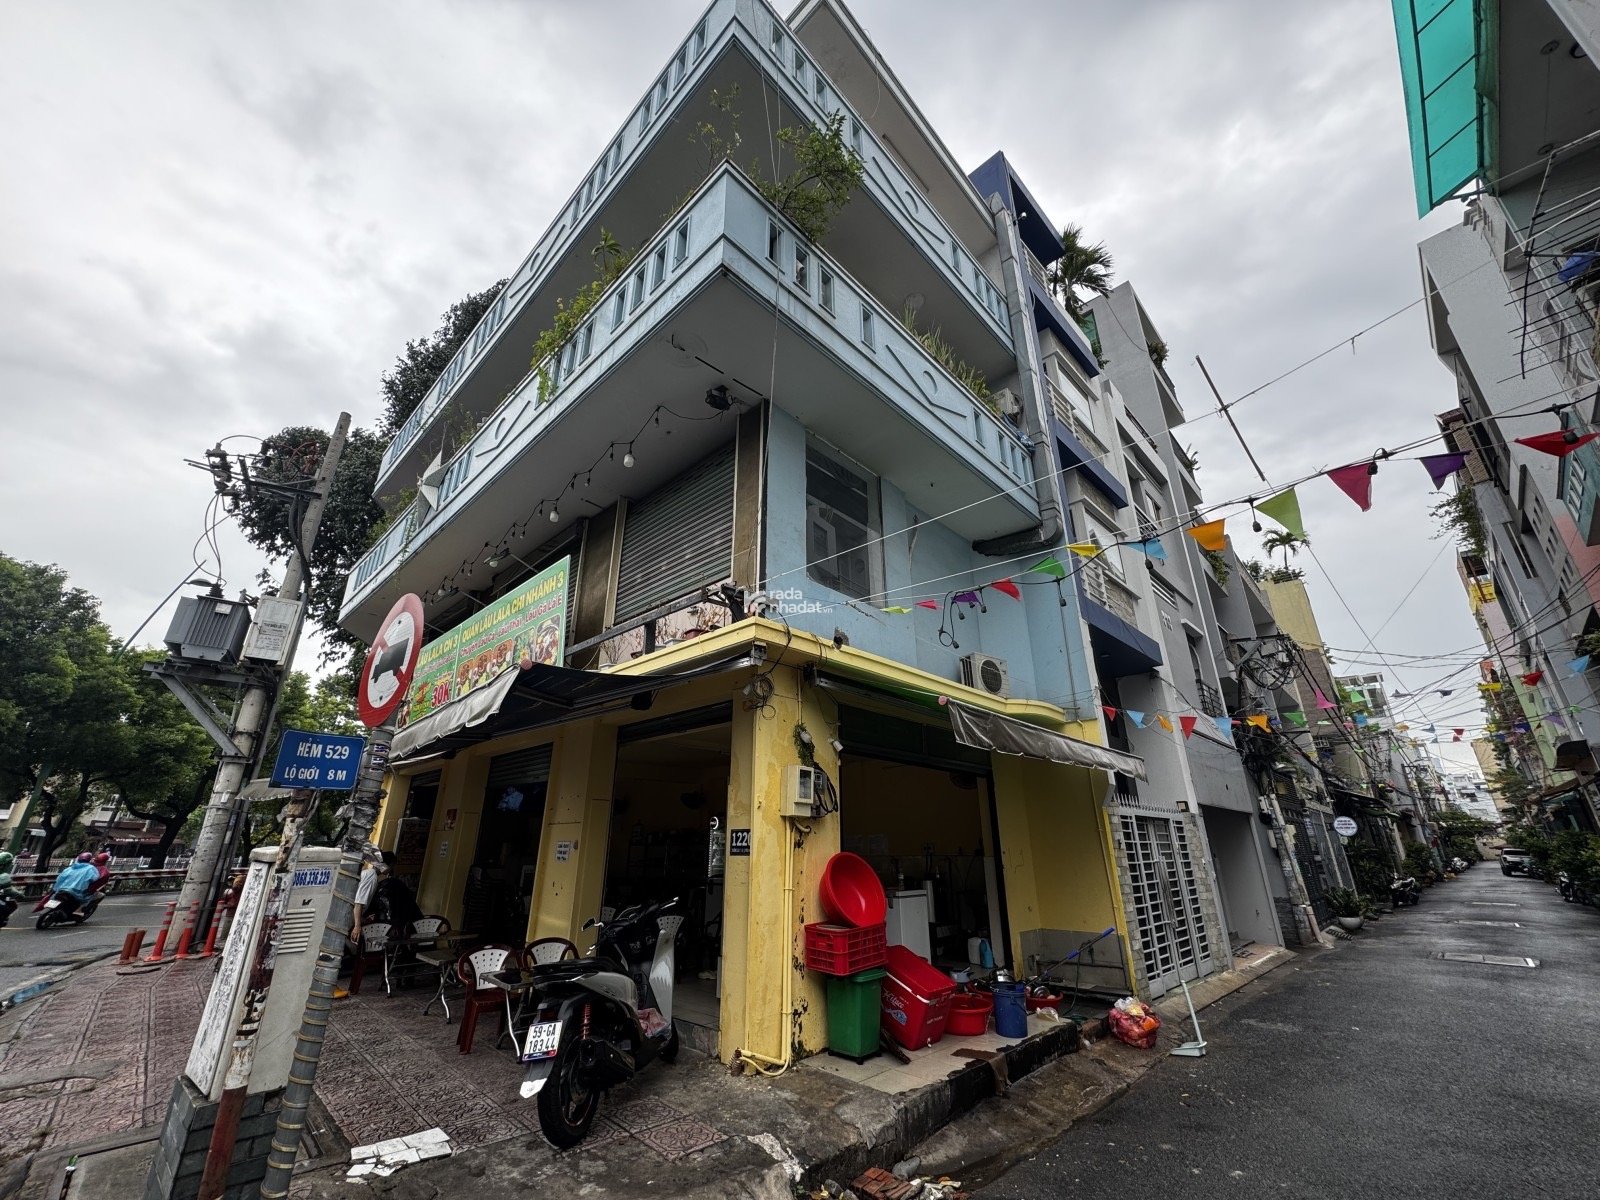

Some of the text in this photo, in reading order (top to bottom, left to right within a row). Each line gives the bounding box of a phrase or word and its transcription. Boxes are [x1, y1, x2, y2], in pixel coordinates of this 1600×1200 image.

[493, 603, 510, 625] LALA
[511, 593, 525, 614] CHI
[526, 575, 557, 606] NHÁNH
[557, 570, 564, 588] 3
[297, 738, 350, 760] HẺM 529
[284, 764, 347, 781] LỘ GIỚI 8 M
